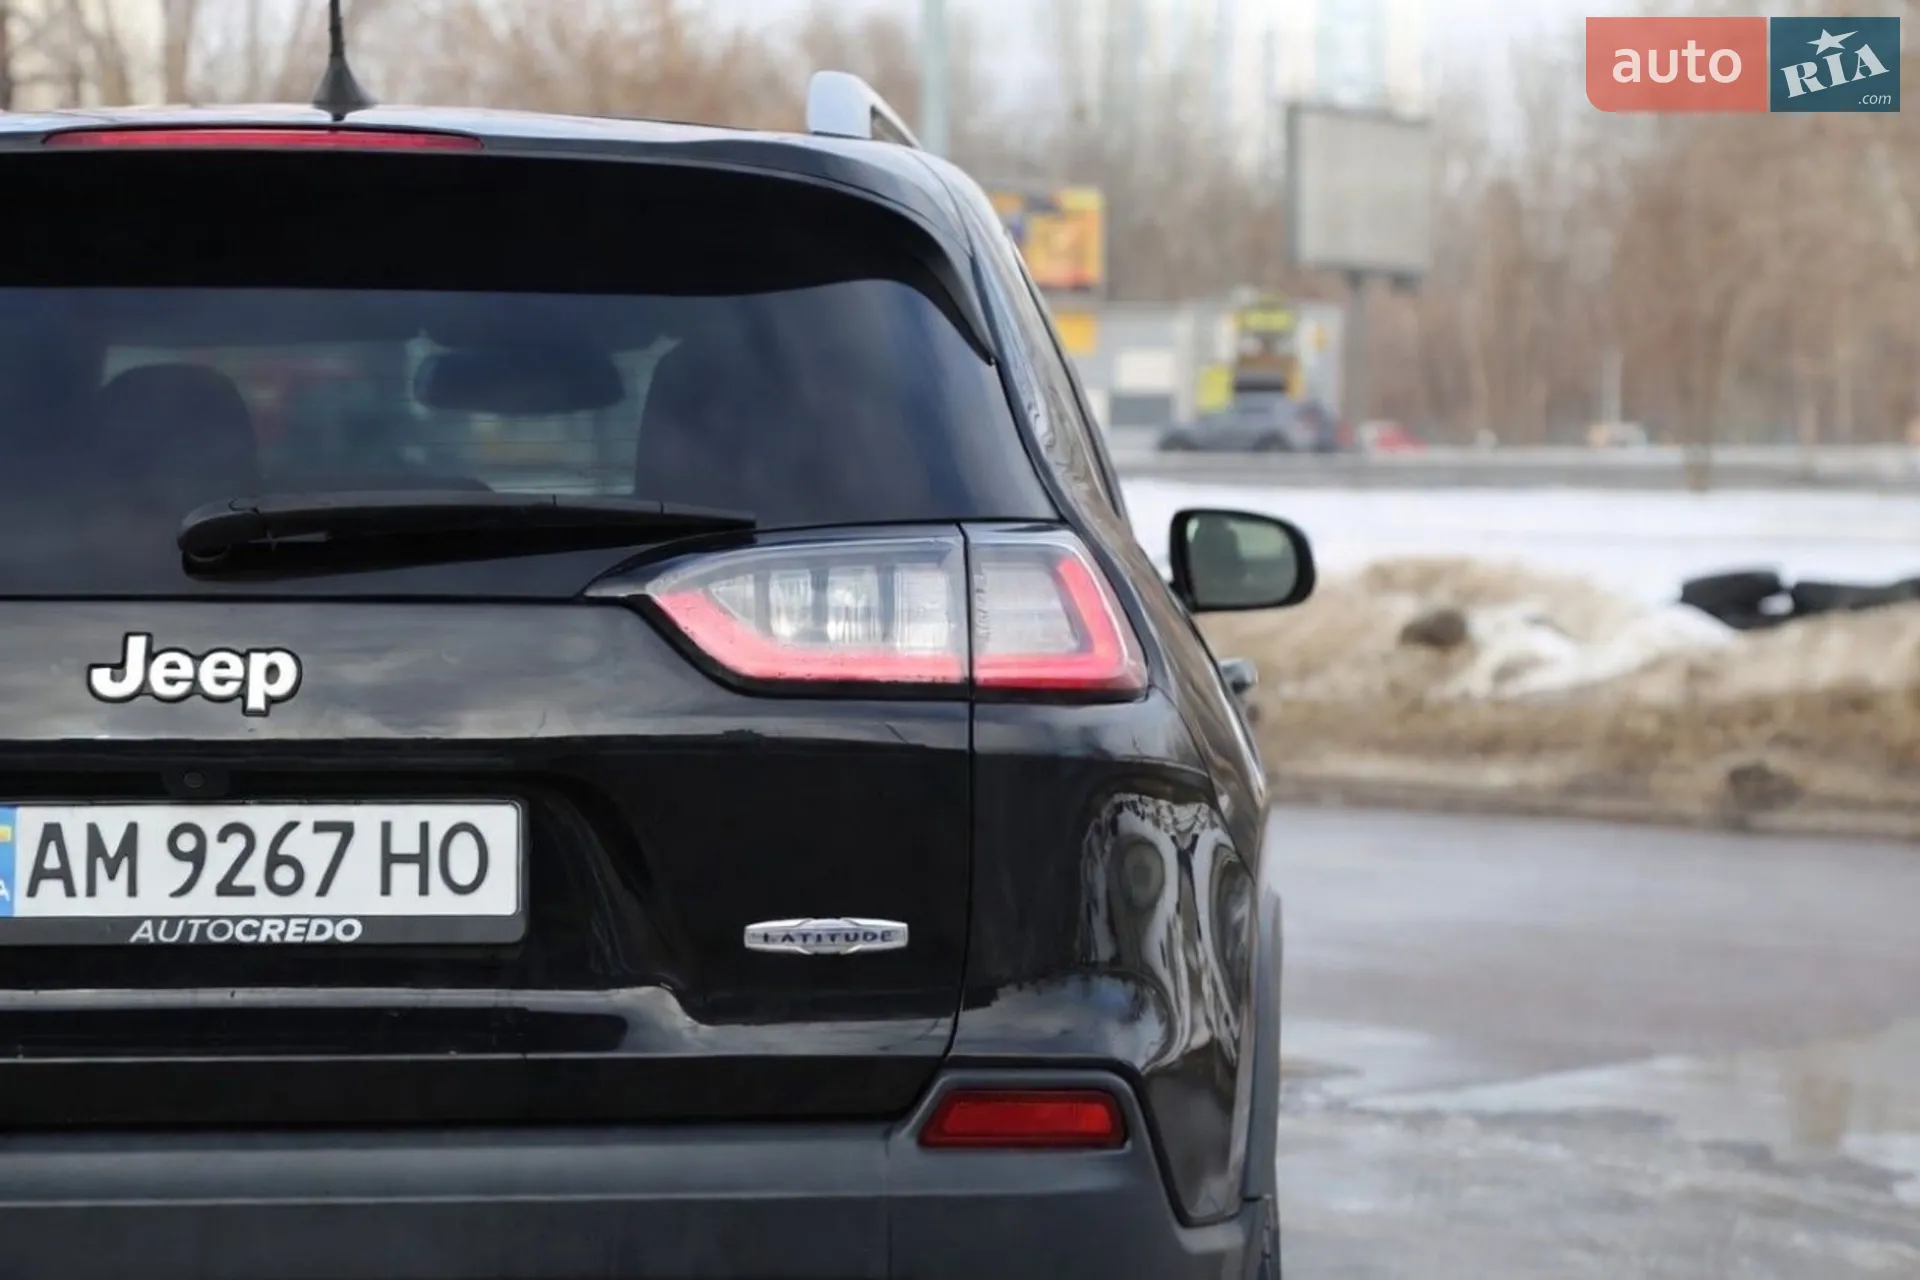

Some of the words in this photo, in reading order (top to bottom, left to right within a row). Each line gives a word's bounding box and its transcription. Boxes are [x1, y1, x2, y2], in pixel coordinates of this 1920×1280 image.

[88, 633, 302, 715] Jeep
[26, 821, 139, 898] AM
[167, 821, 355, 898] 9267
[380, 821, 489, 897] HO
[130, 917, 363, 943] AUTOCREDO
[762, 930, 894, 944] LATITUDE
